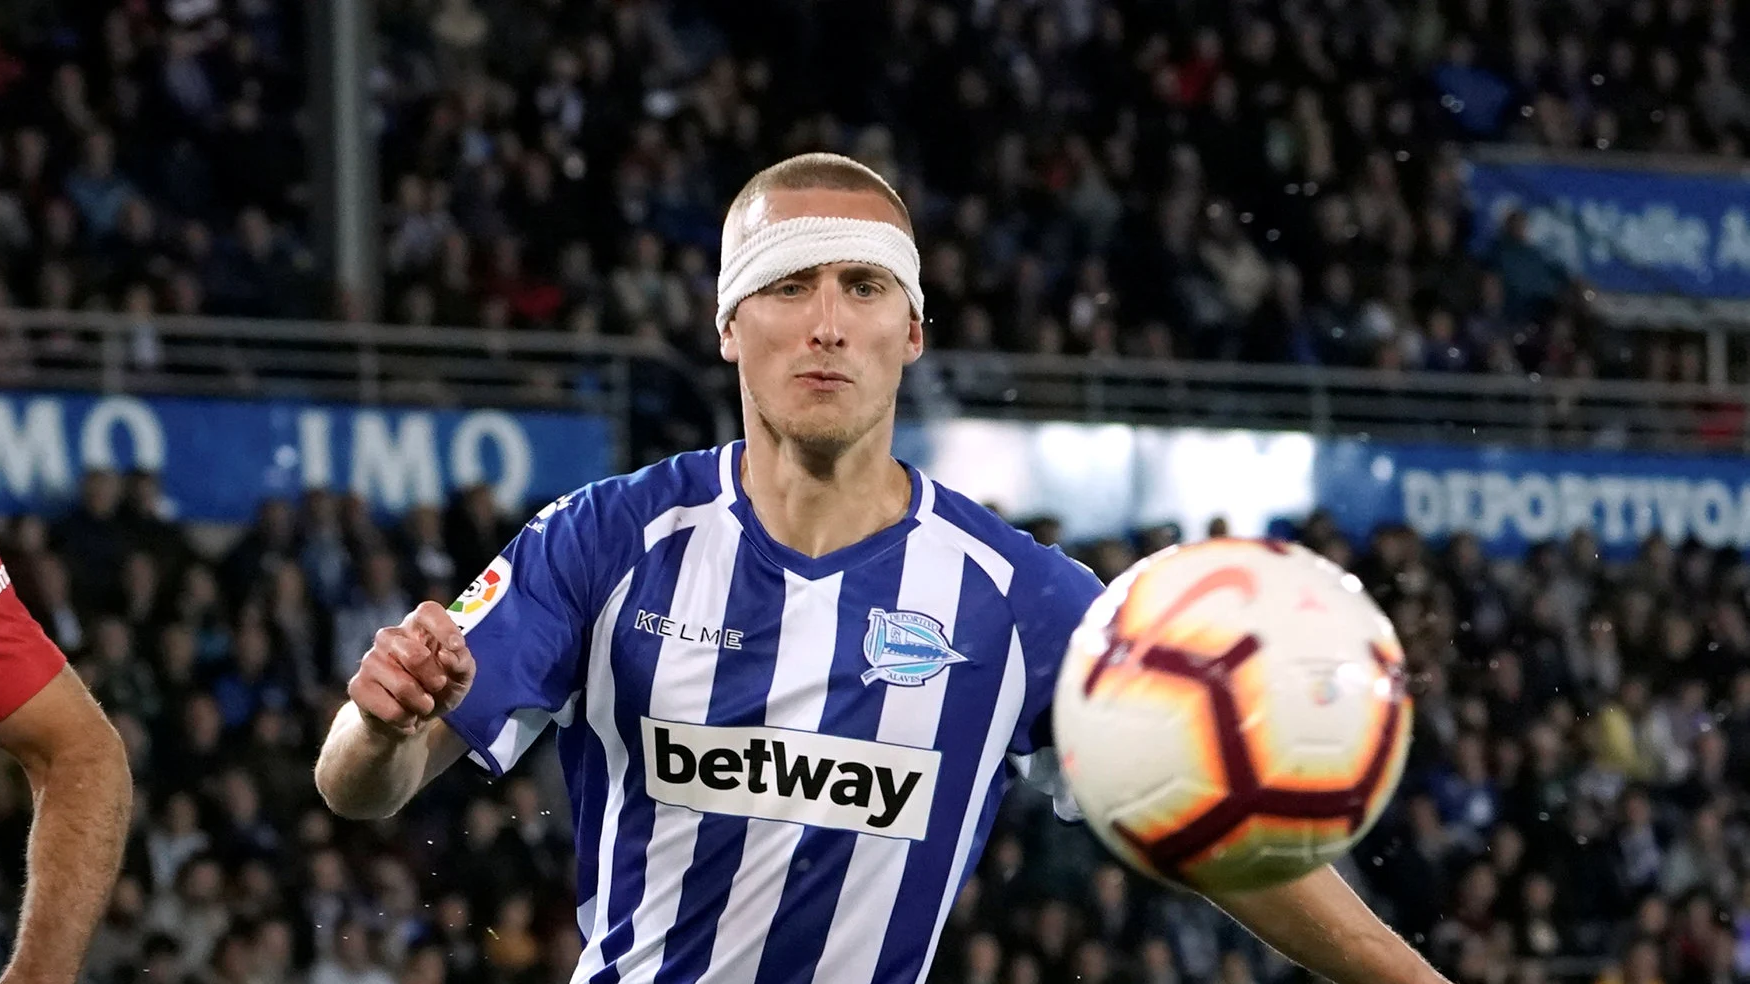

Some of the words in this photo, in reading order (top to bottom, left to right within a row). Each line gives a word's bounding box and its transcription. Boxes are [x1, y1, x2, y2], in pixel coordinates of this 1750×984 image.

[634, 609, 744, 650] KELME
[888, 612, 939, 632] DEPORTIVO
[654, 726, 923, 829] betway
